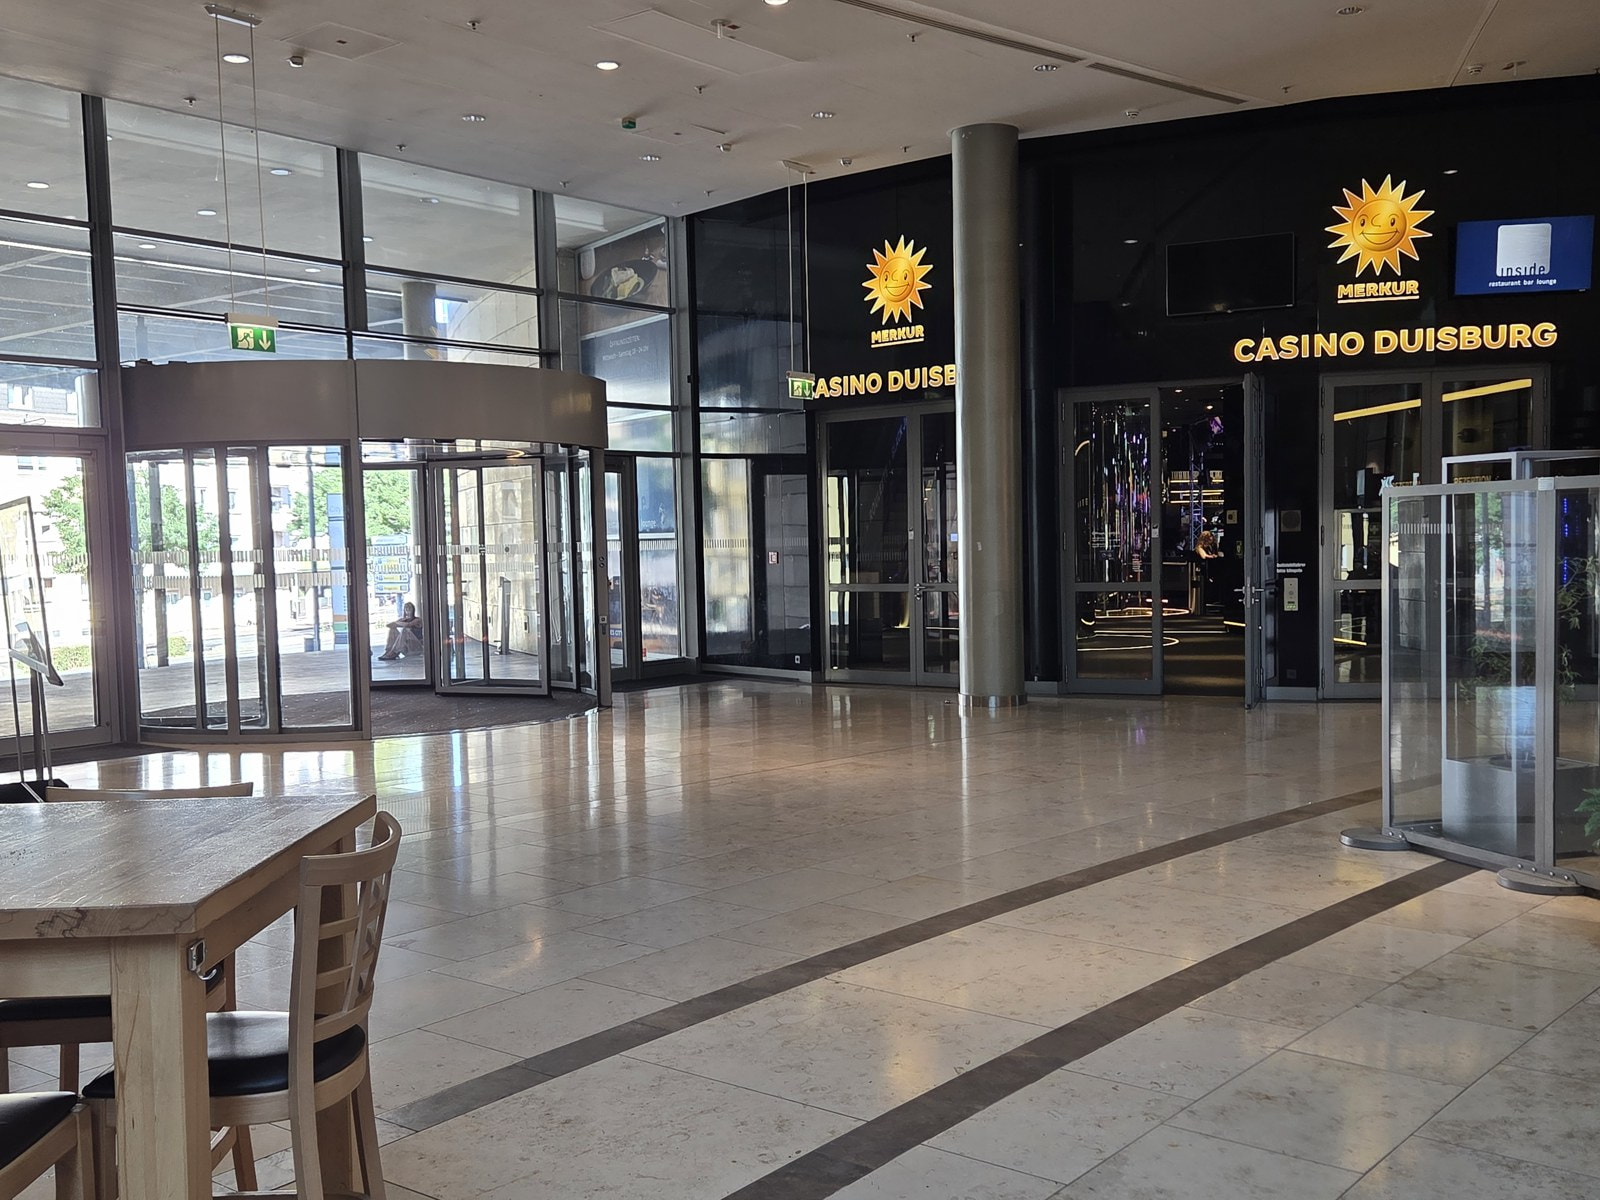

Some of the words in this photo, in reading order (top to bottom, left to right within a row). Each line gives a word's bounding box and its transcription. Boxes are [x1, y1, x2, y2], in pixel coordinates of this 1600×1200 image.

[1500, 263, 1546, 277] inside
[1337, 280, 1419, 299] MERKUR
[1488, 279, 1521, 288] restaurant
[1536, 278, 1557, 287] lounge
[871, 325, 924, 343] MERKUR
[1233, 331, 1365, 364] CASINO
[1374, 322, 1558, 355] DUISBURG
[812, 373, 882, 398] ASINO
[888, 364, 956, 392] DUISB
